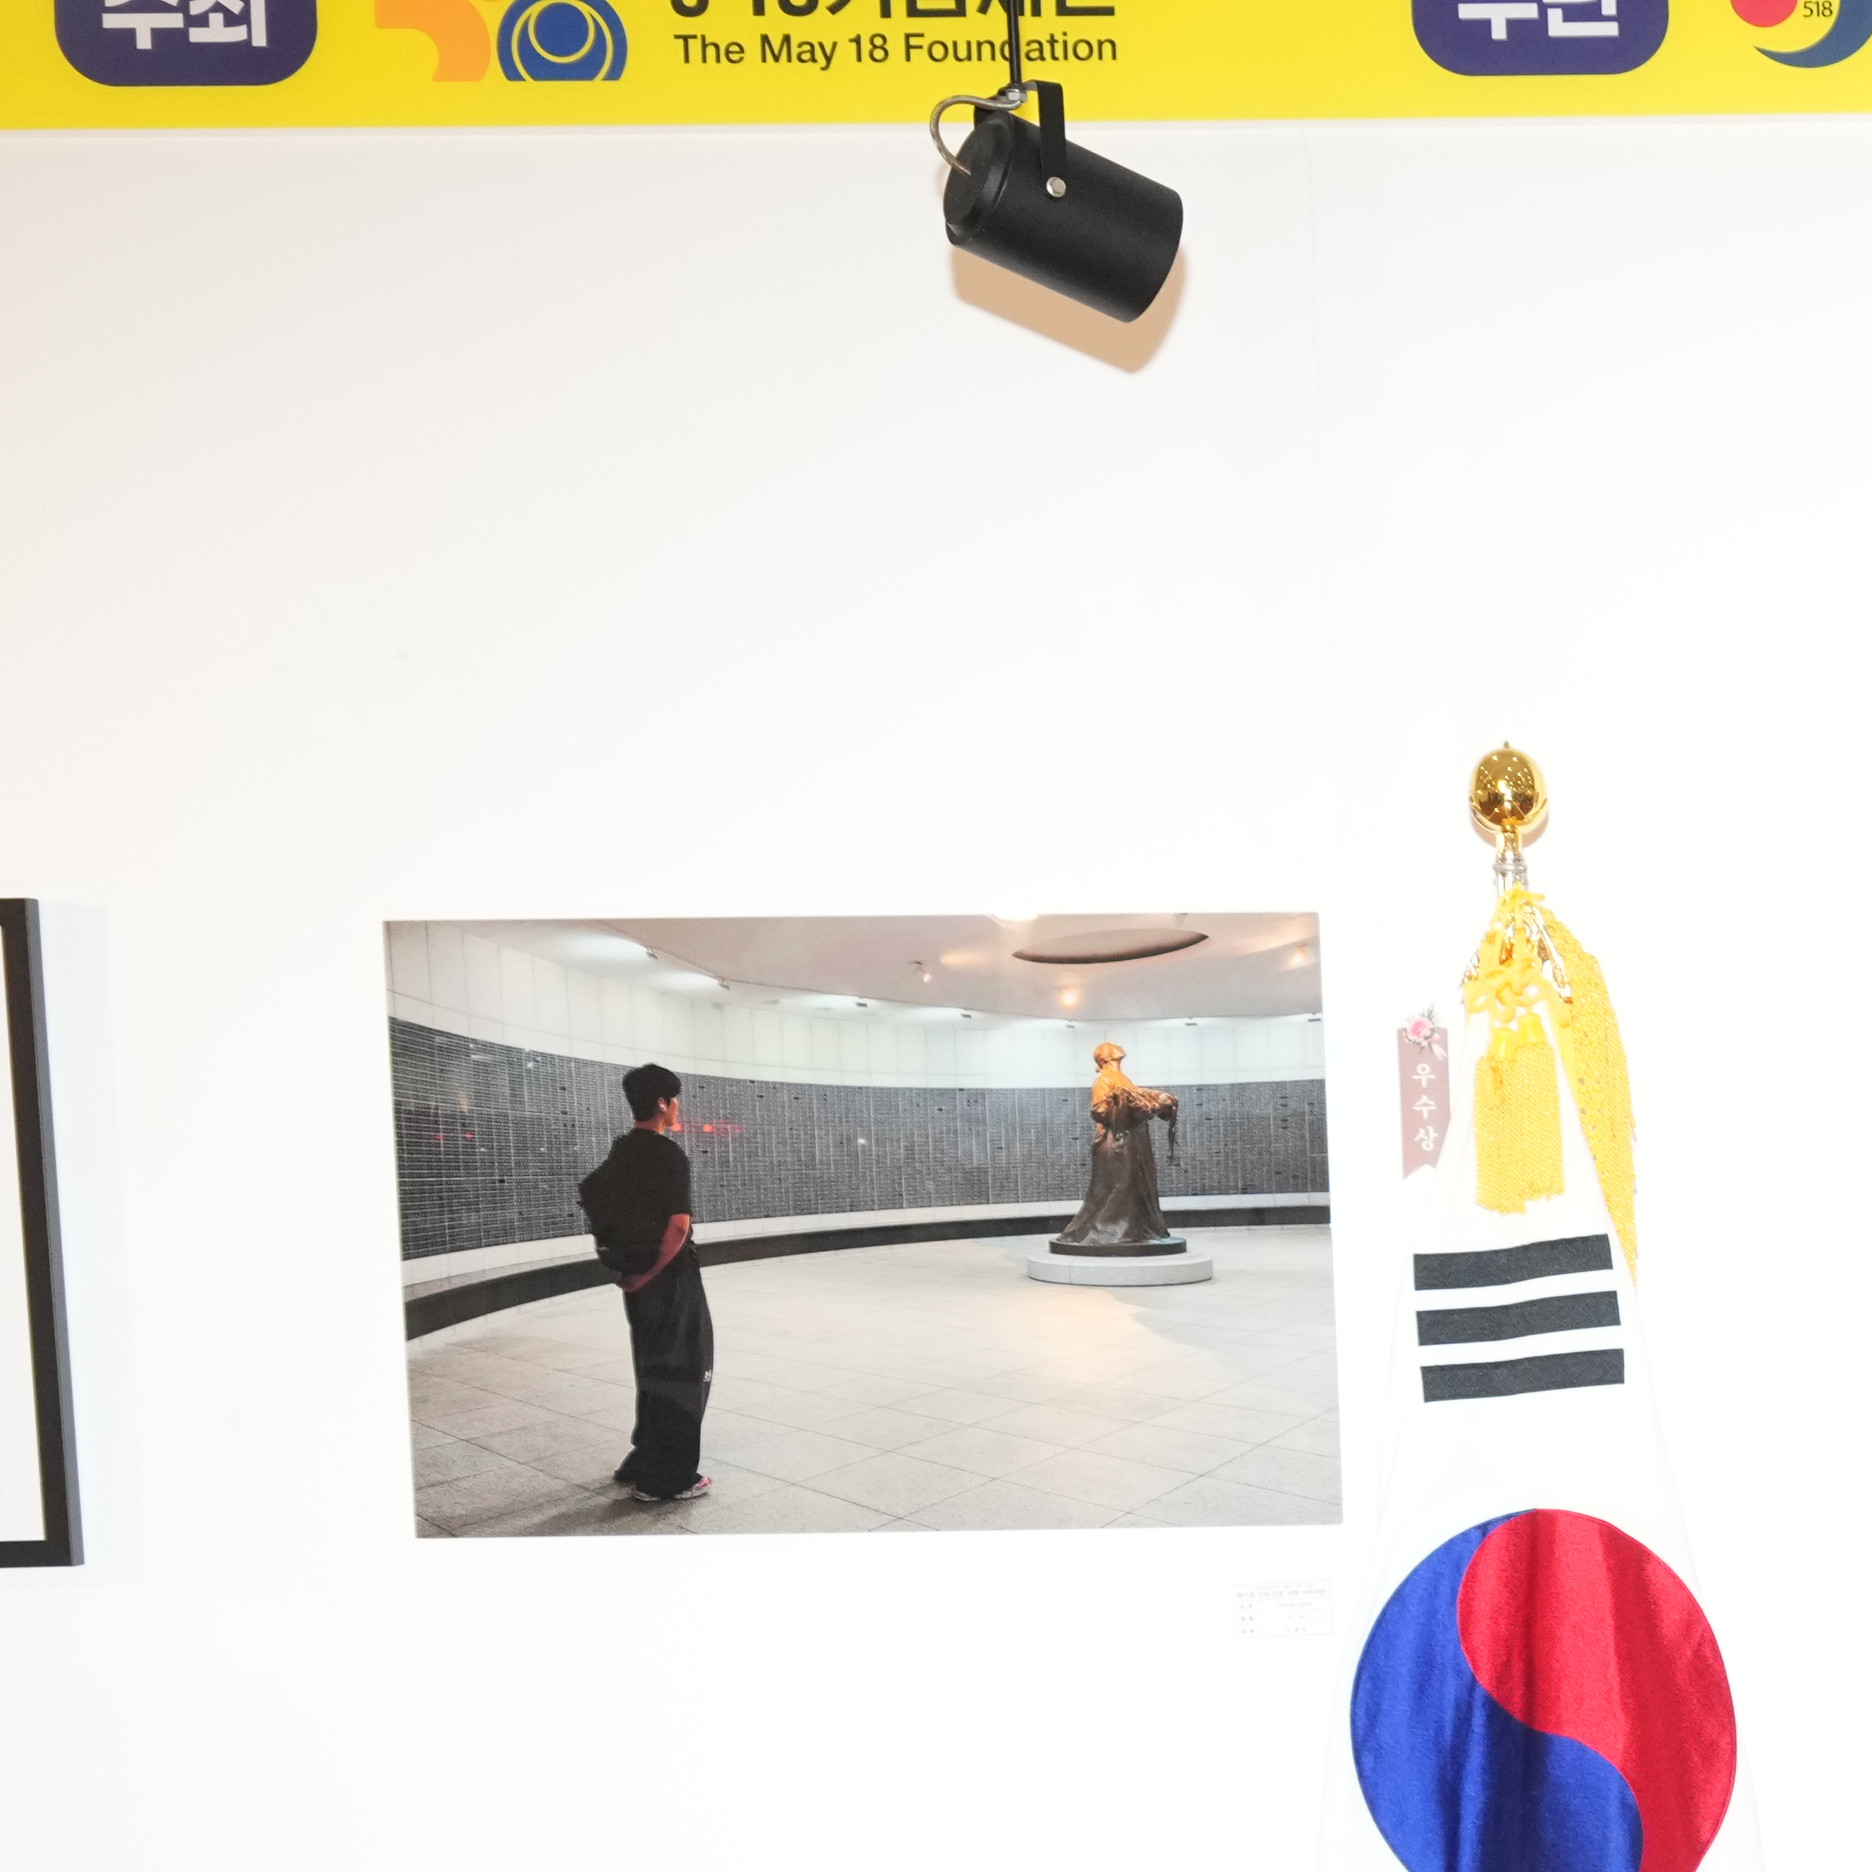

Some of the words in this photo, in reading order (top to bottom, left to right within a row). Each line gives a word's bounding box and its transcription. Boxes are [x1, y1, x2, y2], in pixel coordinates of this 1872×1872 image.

[1802, 0, 1833, 17] 518
[674, 33, 745, 63] The
[760, 33, 837, 71] May
[848, 33, 890, 63] 18
[1411, 1063, 1440, 1151] 우수상
